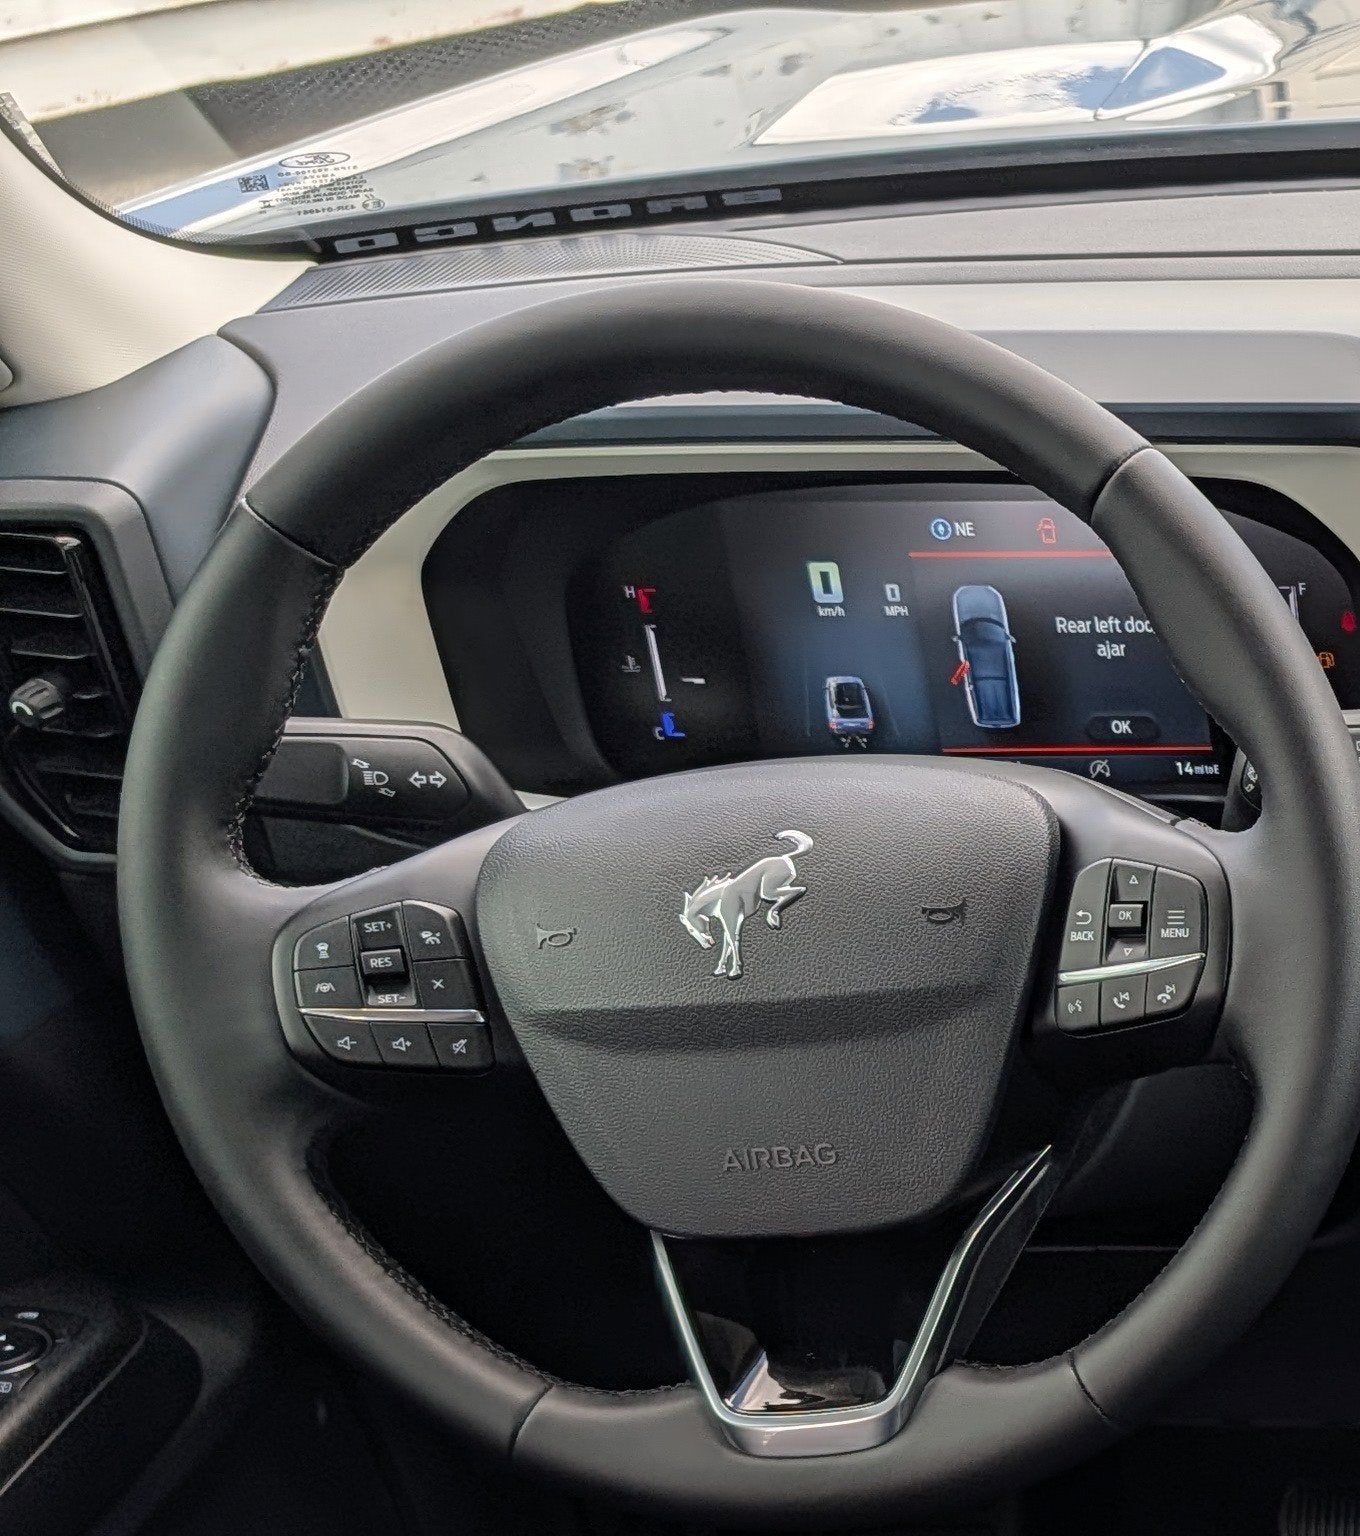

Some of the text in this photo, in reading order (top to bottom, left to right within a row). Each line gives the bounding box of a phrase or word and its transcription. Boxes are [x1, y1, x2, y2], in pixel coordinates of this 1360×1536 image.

[954, 521, 976, 538] NE
[806, 560, 844, 604] 0
[1298, 582, 1307, 596] F
[624, 586, 636, 598] H
[884, 583, 900, 602] 0
[817, 606, 846, 618] km/h
[884, 606, 910, 618] MPH
[1055, 615, 1156, 635] Rear left doo
[1096, 641, 1126, 660] ajar
[1110, 720, 1132, 734] OK
[1175, 761, 1194, 776] 14
[1118, 910, 1132, 921] OK
[1070, 930, 1094, 942] BACK
[1160, 928, 1190, 938] MENU
[370, 956, 393, 968] RES
